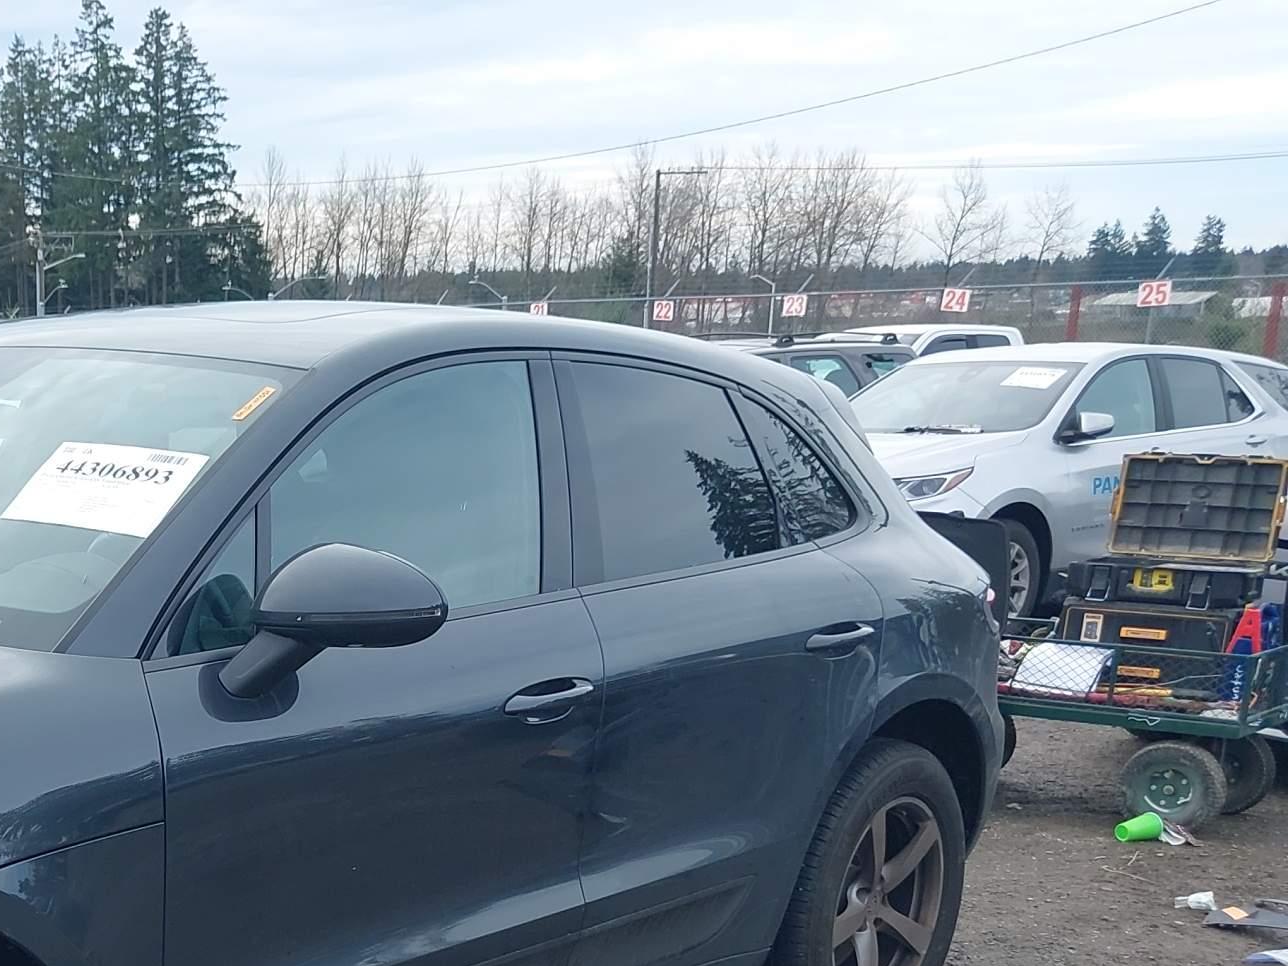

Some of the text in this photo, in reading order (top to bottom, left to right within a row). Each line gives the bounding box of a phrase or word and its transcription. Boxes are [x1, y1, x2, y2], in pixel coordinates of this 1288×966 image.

[943, 290, 968, 310] 24
[1139, 283, 1167, 305] 25
[533, 303, 546, 315] 21
[655, 302, 672, 319] 22
[785, 297, 804, 315] 23
[56, 460, 174, 485] 44306893
